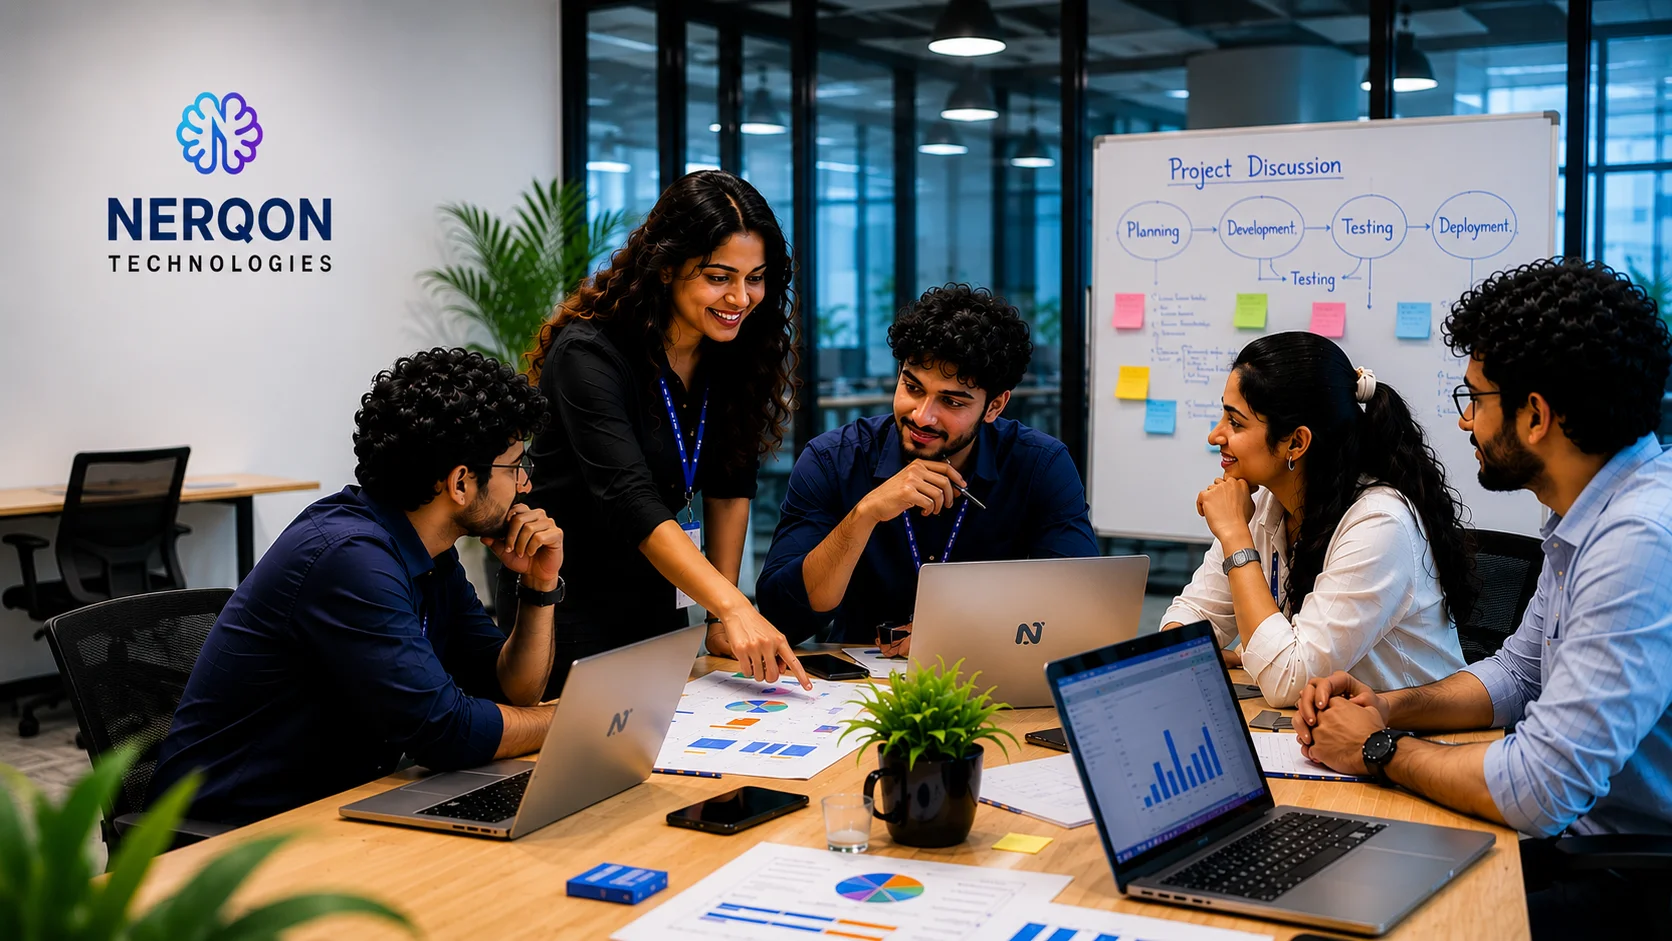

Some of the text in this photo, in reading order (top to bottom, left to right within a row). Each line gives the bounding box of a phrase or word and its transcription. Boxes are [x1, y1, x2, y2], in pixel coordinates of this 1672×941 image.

[1168, 154, 1342, 190] Project Discussion
[107, 197, 332, 244] NERQON
[1341, 218, 1393, 241] Testing
[1127, 221, 1180, 245] Planning
[108, 254, 332, 272] TECHNOLOGIES
[1290, 271, 1335, 292] Testing
